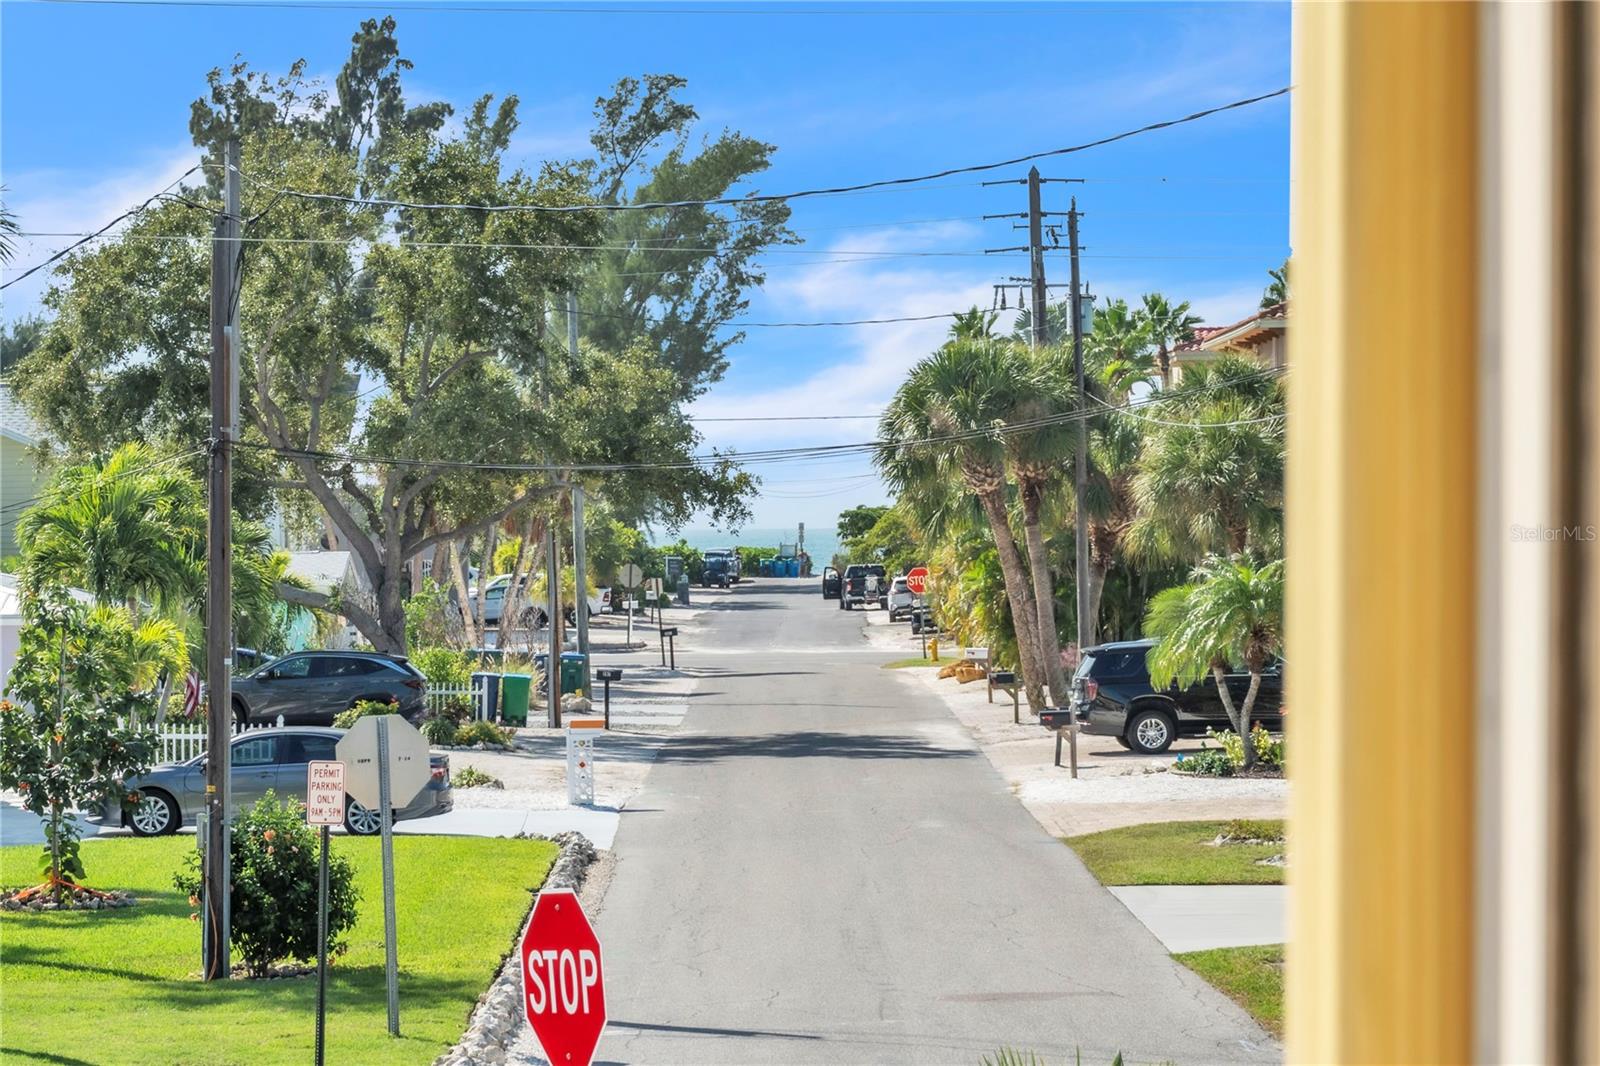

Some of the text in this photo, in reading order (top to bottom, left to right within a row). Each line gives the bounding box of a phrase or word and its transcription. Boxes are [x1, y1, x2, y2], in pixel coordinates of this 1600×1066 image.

[314, 769, 340, 778] PERMIT
[311, 781, 342, 791] PARKING
[317, 794, 335, 804] ONLY
[528, 949, 598, 1015] STOP
